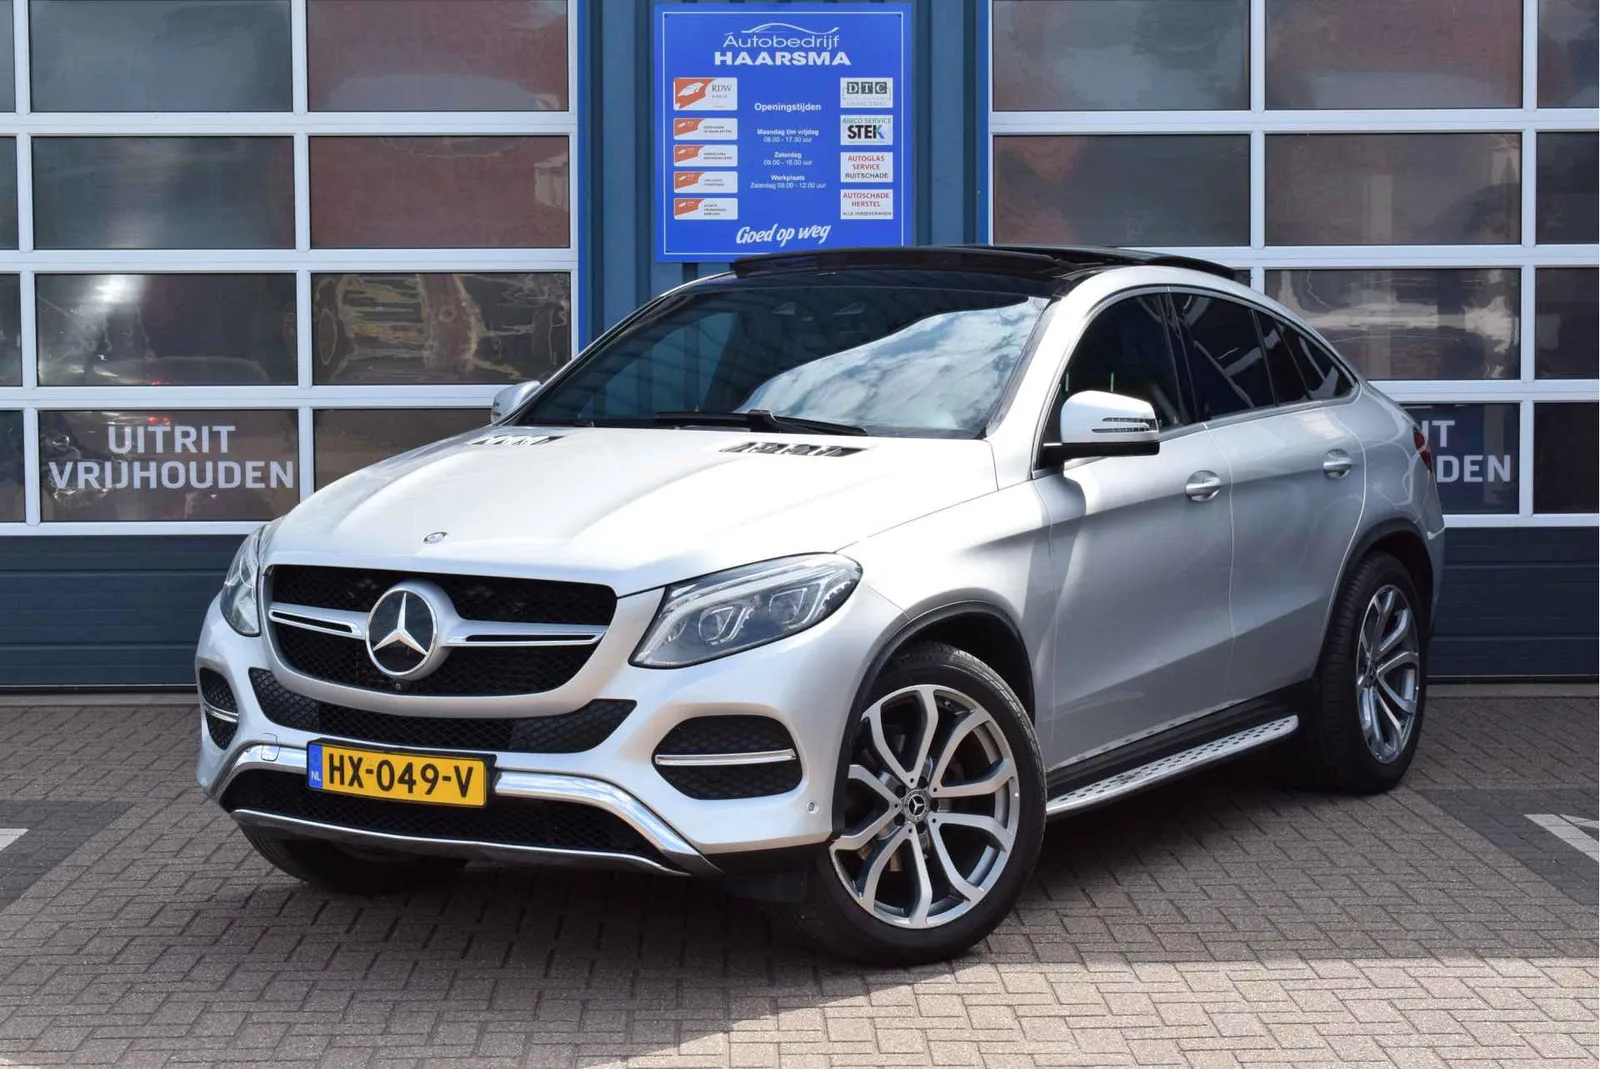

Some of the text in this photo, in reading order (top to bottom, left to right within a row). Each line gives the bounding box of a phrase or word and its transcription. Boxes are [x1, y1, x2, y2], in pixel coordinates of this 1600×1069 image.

[723, 33, 840, 50] Autobedrijf
[714, 51, 851, 66] HAARSMA
[846, 81, 887, 94] DTC
[754, 102, 822, 112] Openingstijden
[757, 128, 785, 136] Maandag
[798, 128, 819, 136] vrijdag
[847, 124, 885, 139] STEK
[774, 151, 802, 159] Zaterdag
[770, 174, 805, 182] Werkplaats
[735, 223, 832, 248] Goed op weg
[108, 425, 236, 453] UITRIT
[49, 460, 294, 489] VRIJHOUDEN
[1436, 455, 1511, 482] DEN
[311, 771, 321, 781] NL
[328, 753, 474, 798] HX-049-V
